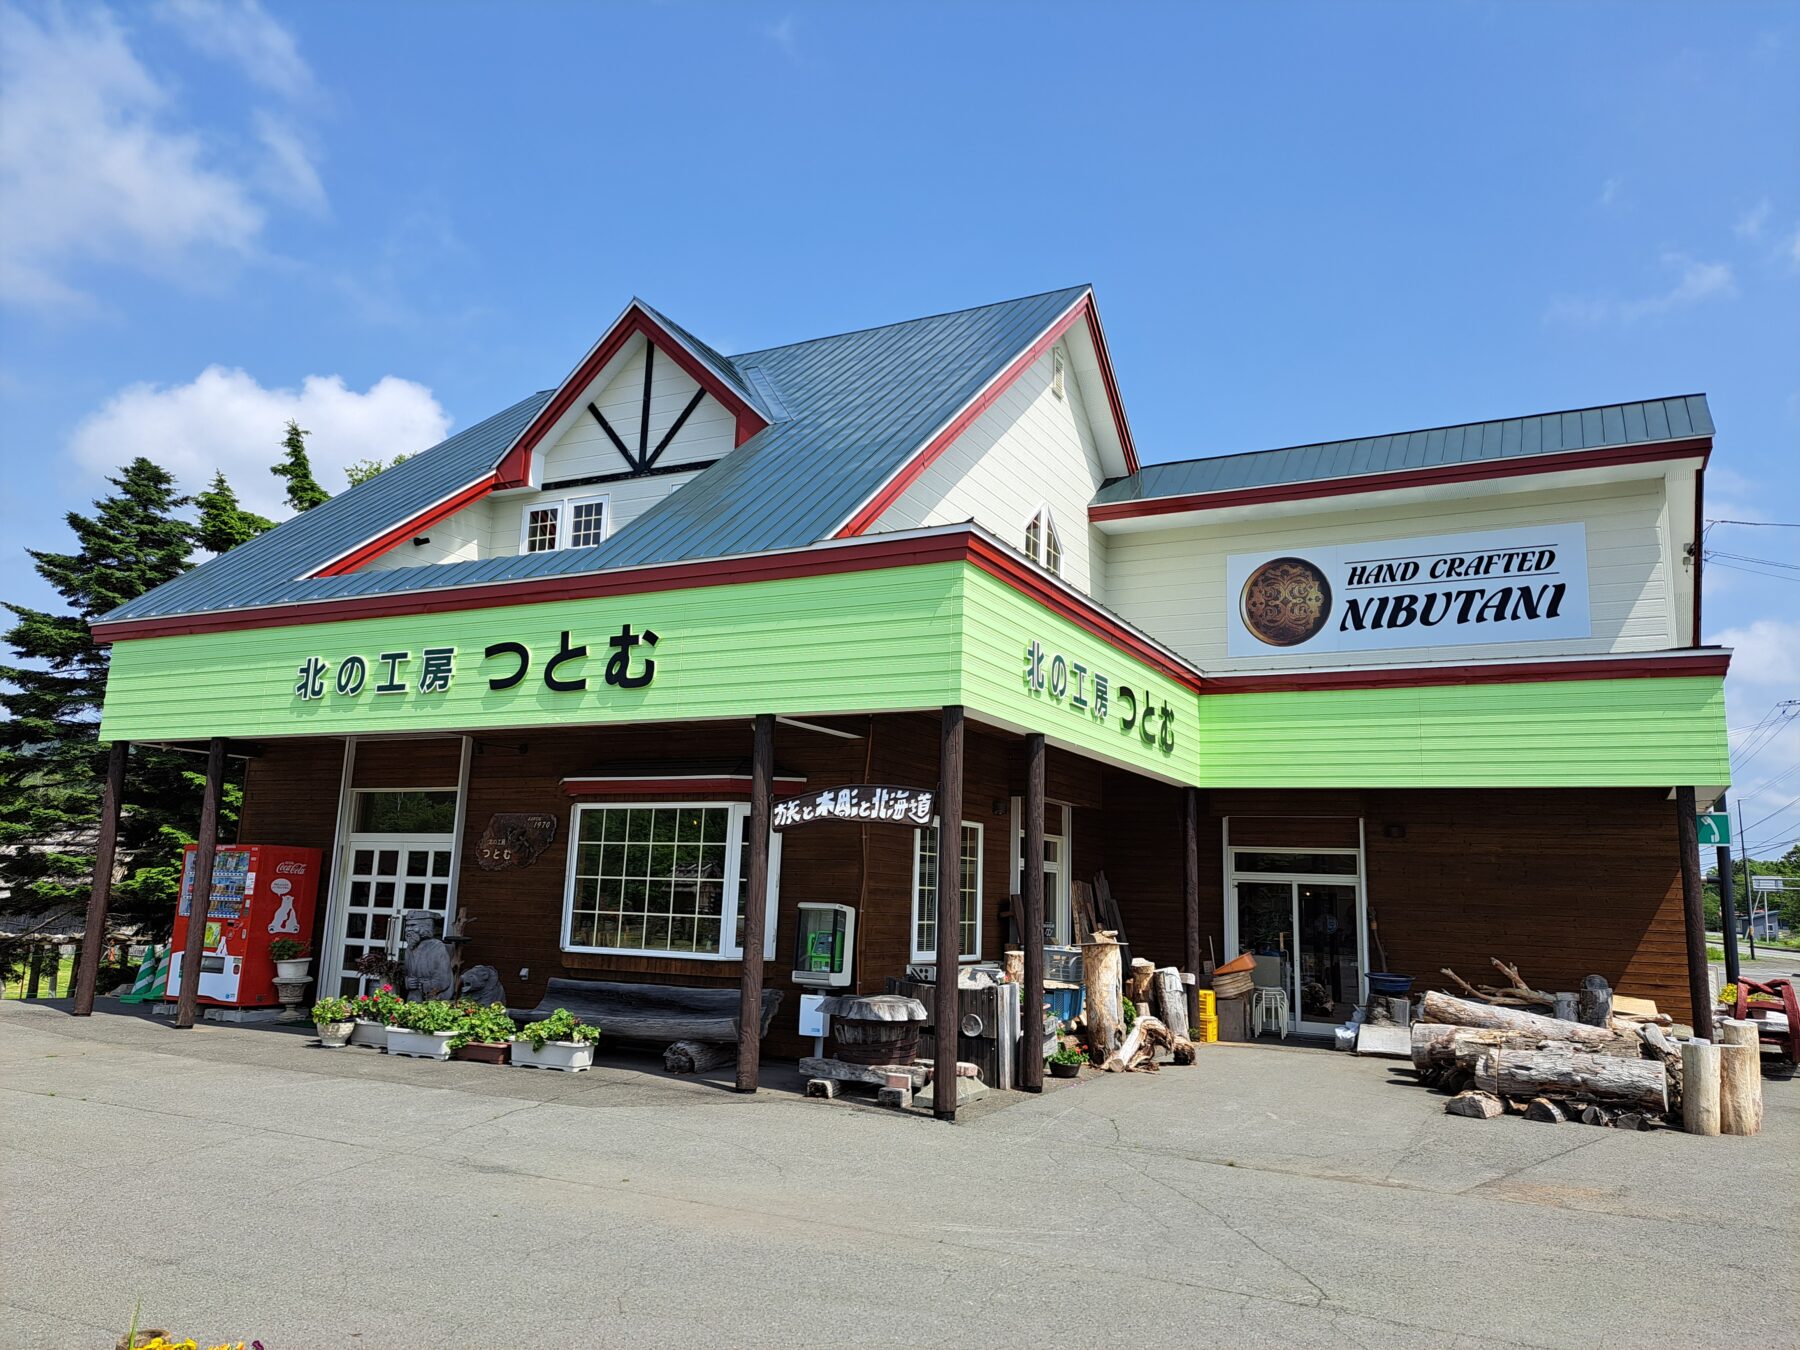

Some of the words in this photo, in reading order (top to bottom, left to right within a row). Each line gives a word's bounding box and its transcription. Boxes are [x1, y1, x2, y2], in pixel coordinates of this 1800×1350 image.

[1347, 561, 1420, 586] HAND
[1429, 549, 1556, 579] CRAFTED
[1339, 582, 1567, 632] NIBUTANI
[295, 646, 458, 701] 北の工房
[484, 623, 661, 692] つとむ
[1025, 639, 1109, 720] 北の工房
[1117, 685, 1175, 753] つとむ
[533, 821, 551, 829] 1970
[773, 787, 933, 827] 旅と木彫と北海道
[482, 848, 512, 860] つとむ
